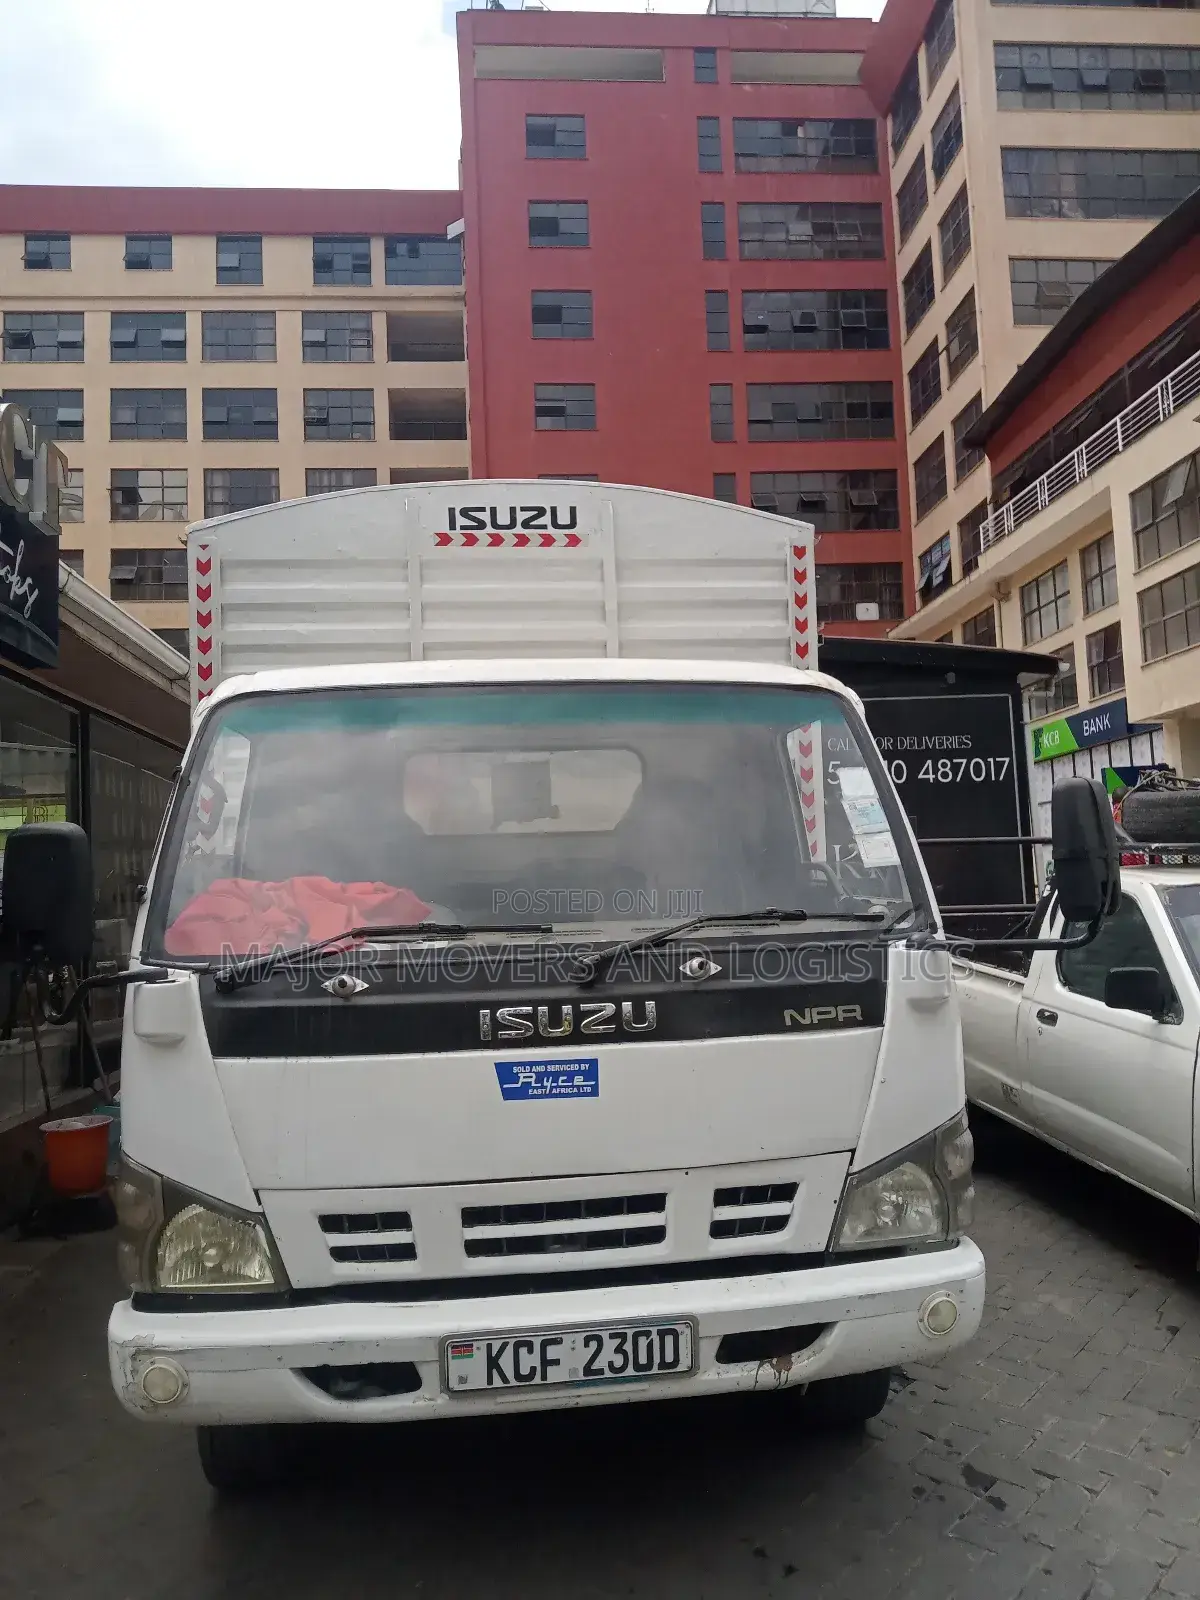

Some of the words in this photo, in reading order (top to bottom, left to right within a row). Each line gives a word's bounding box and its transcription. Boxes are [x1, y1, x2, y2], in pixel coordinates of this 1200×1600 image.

[447, 505, 578, 531] ISUZU
[874, 736, 893, 750] OR
[897, 735, 972, 750] DELIVERIES
[1043, 730, 1060, 749] KCB
[1082, 712, 1111, 737] BANK
[917, 757, 1010, 783] 487017
[479, 1000, 657, 1041] ISUZU
[783, 1004, 864, 1026] NPR
[547, 1064, 579, 1072] SERVICED
[580, 1063, 590, 1071] BY
[486, 1336, 564, 1386] KCF
[582, 1327, 681, 1378] 230D
